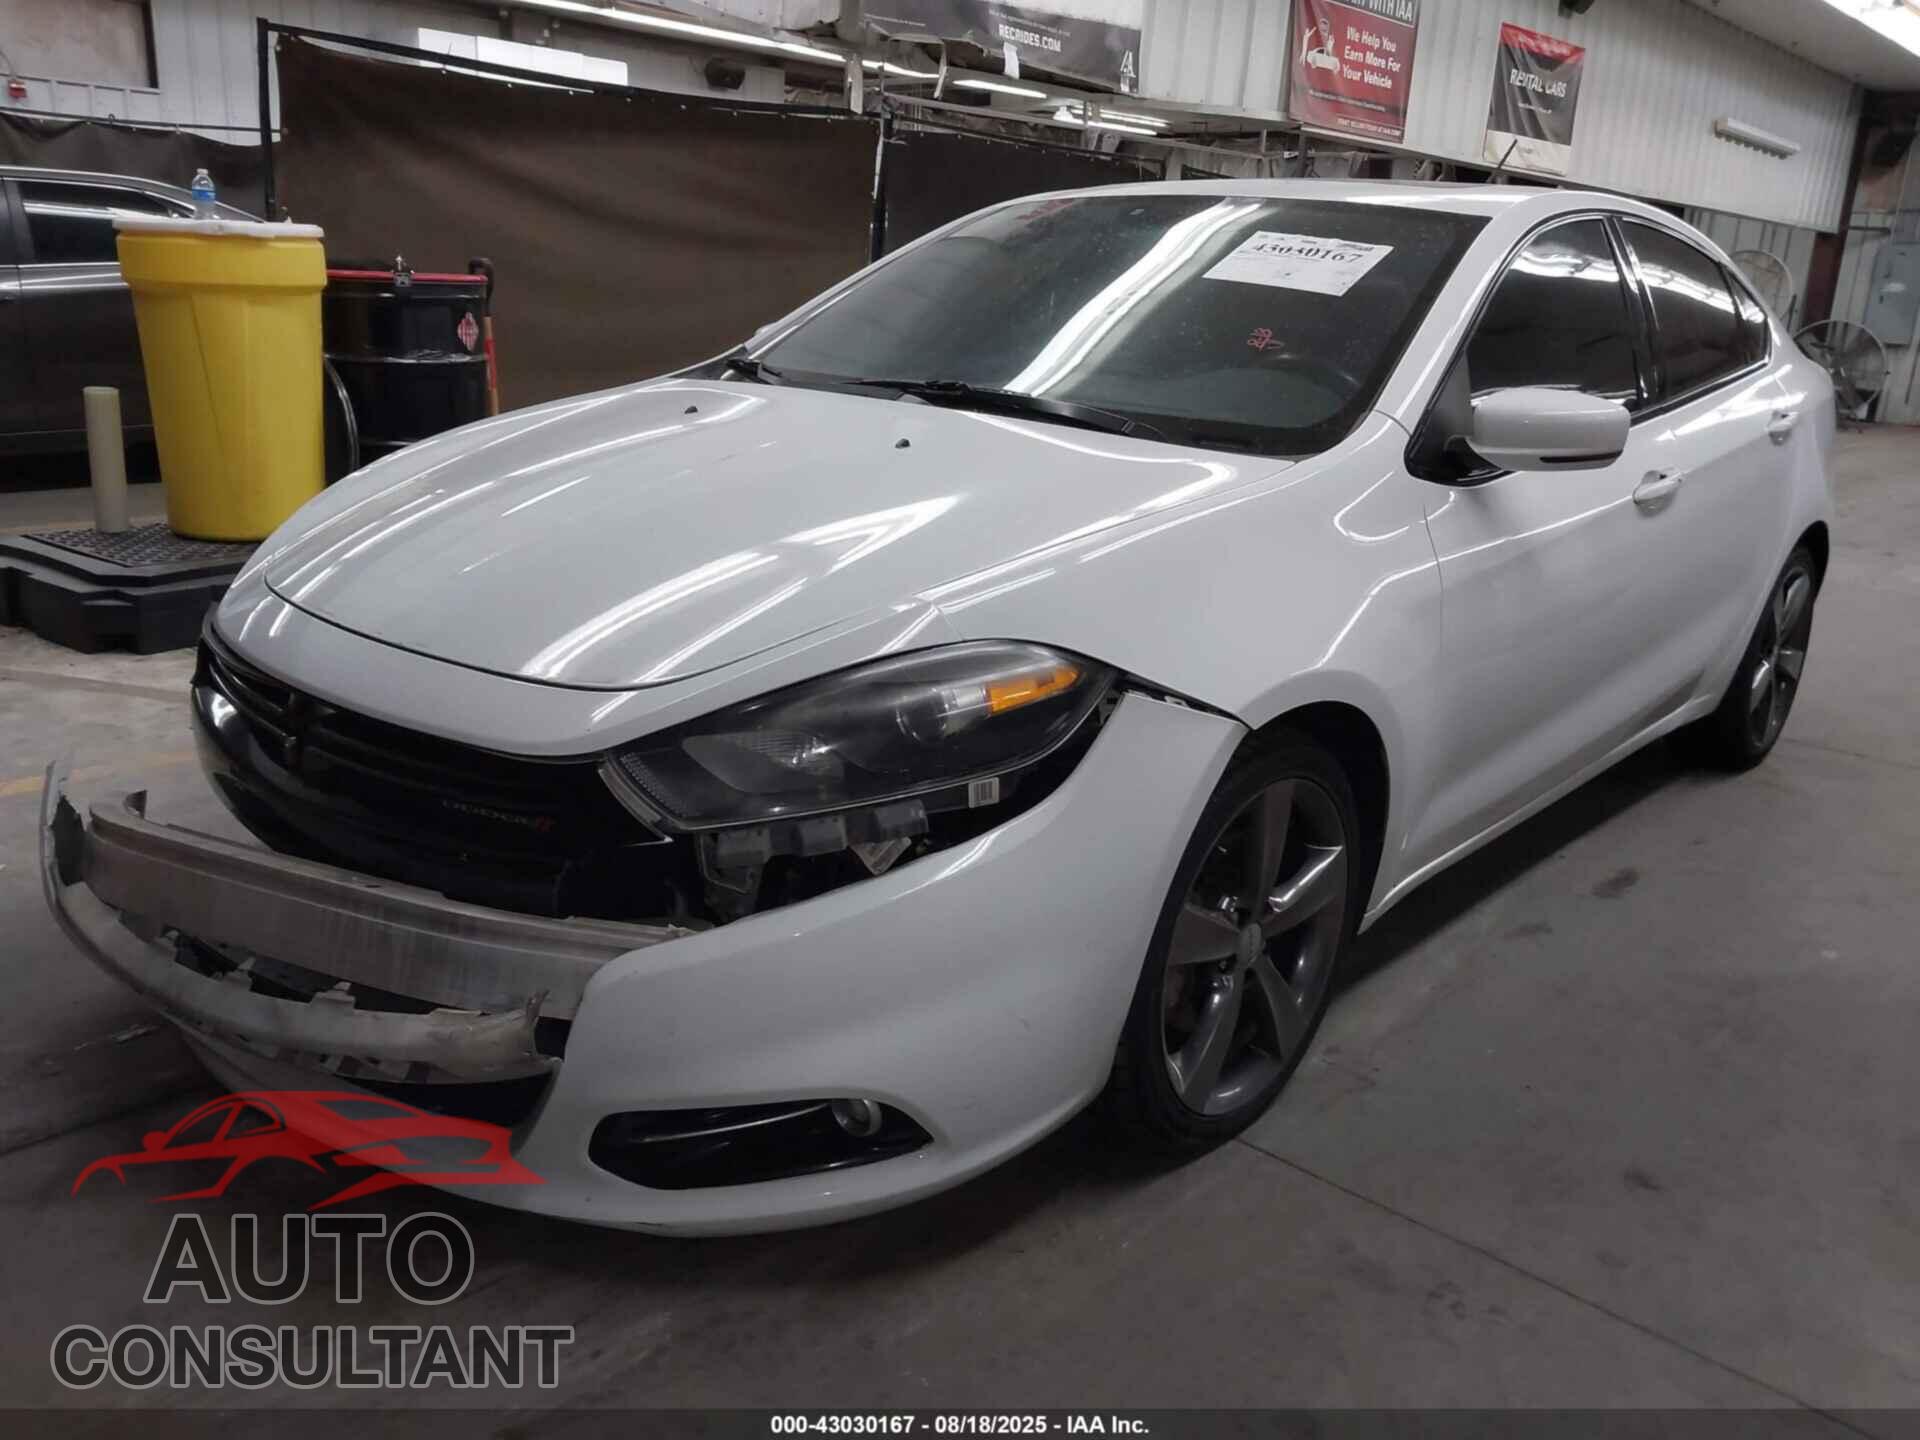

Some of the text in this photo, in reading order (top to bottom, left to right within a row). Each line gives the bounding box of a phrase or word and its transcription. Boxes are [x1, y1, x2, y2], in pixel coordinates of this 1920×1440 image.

[1395, 0, 1413, 21] IAA
[1346, 25, 1397, 52] We Help You
[1344, 45, 1401, 72] Earn More For
[1342, 63, 1392, 88] Your Vehicle
